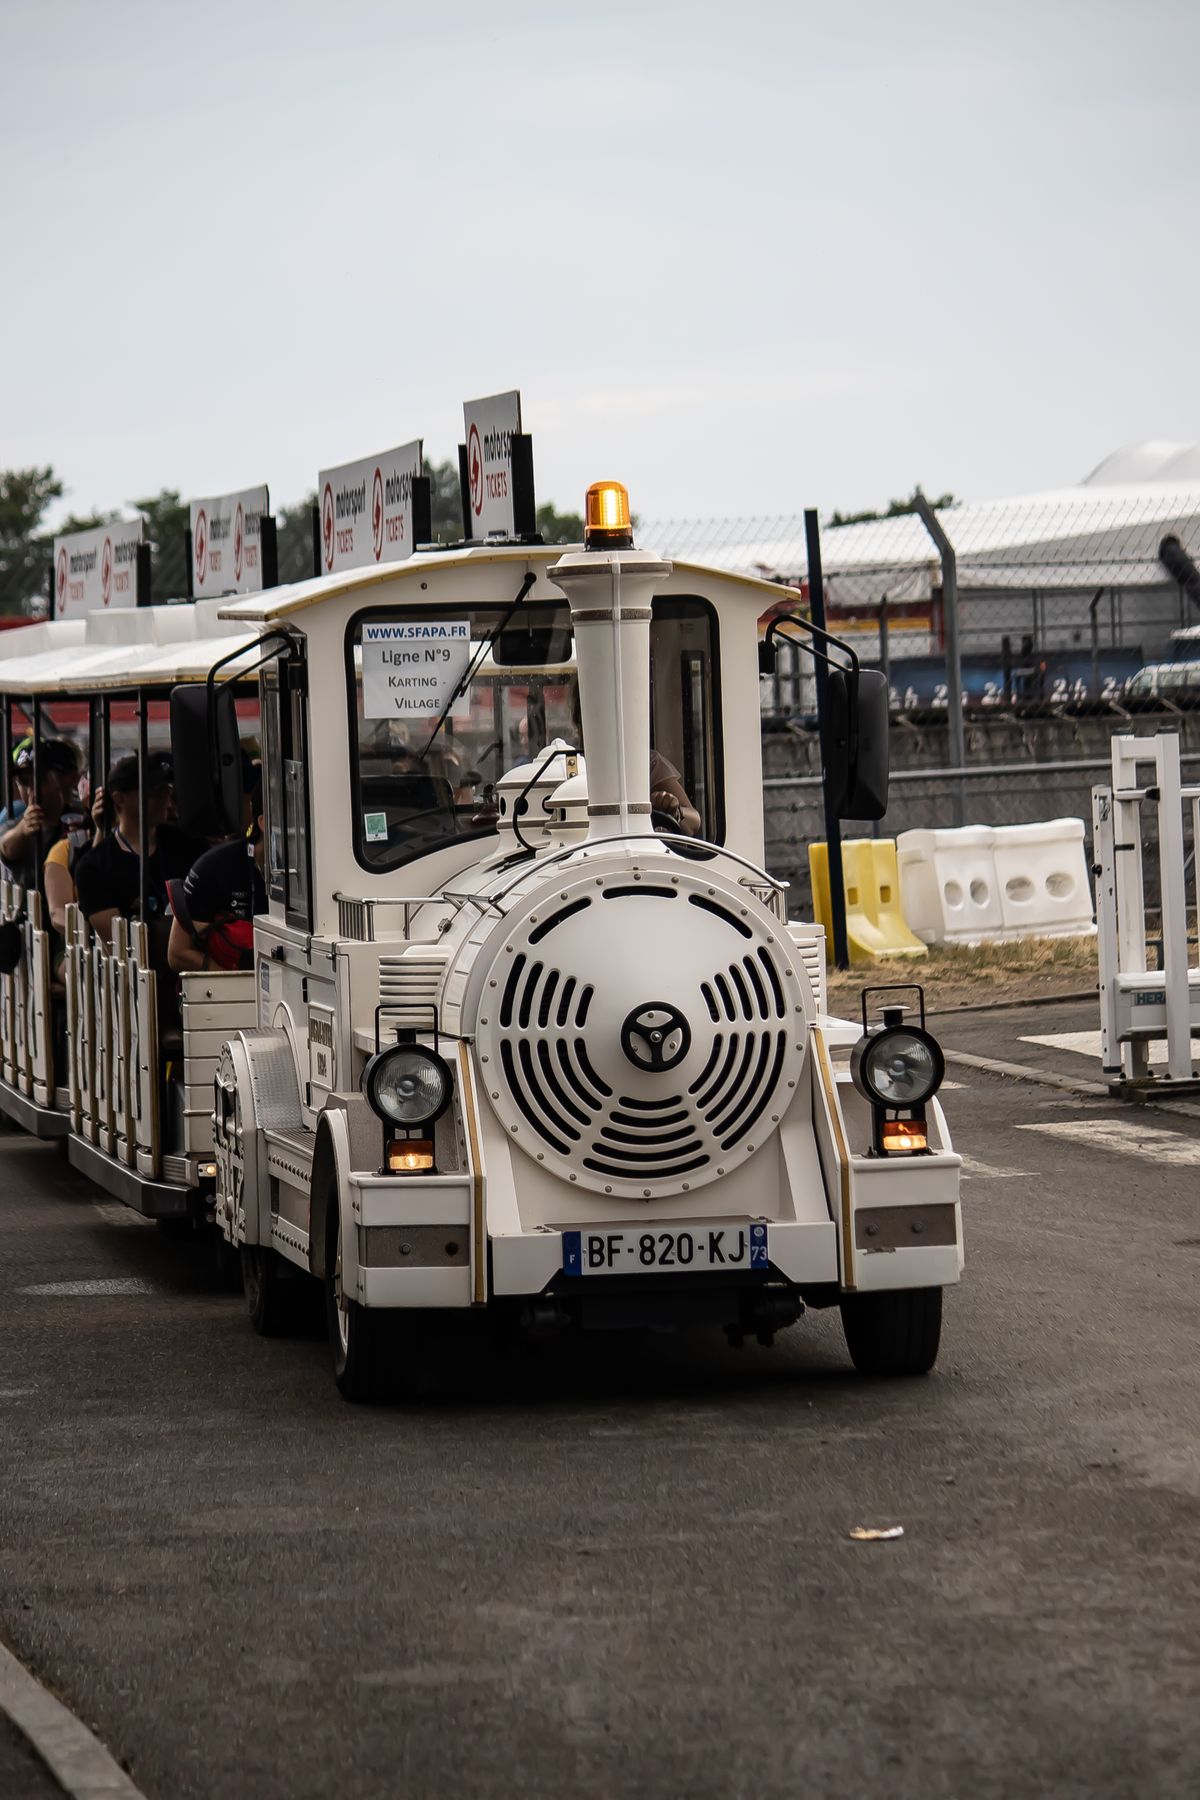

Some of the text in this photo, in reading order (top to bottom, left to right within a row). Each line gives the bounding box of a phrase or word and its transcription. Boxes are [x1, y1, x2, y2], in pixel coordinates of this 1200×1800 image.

[486, 471, 507, 498] TICKETS
[336, 478, 366, 524] motorsport
[367, 626, 467, 639] WWW.SFAPA.FR
[382, 649, 451, 666] Ligne N°9
[588, 1231, 745, 1267] BF-820-KJ
[752, 1246, 767, 1261] 73
[569, 1255, 576, 1264] F
